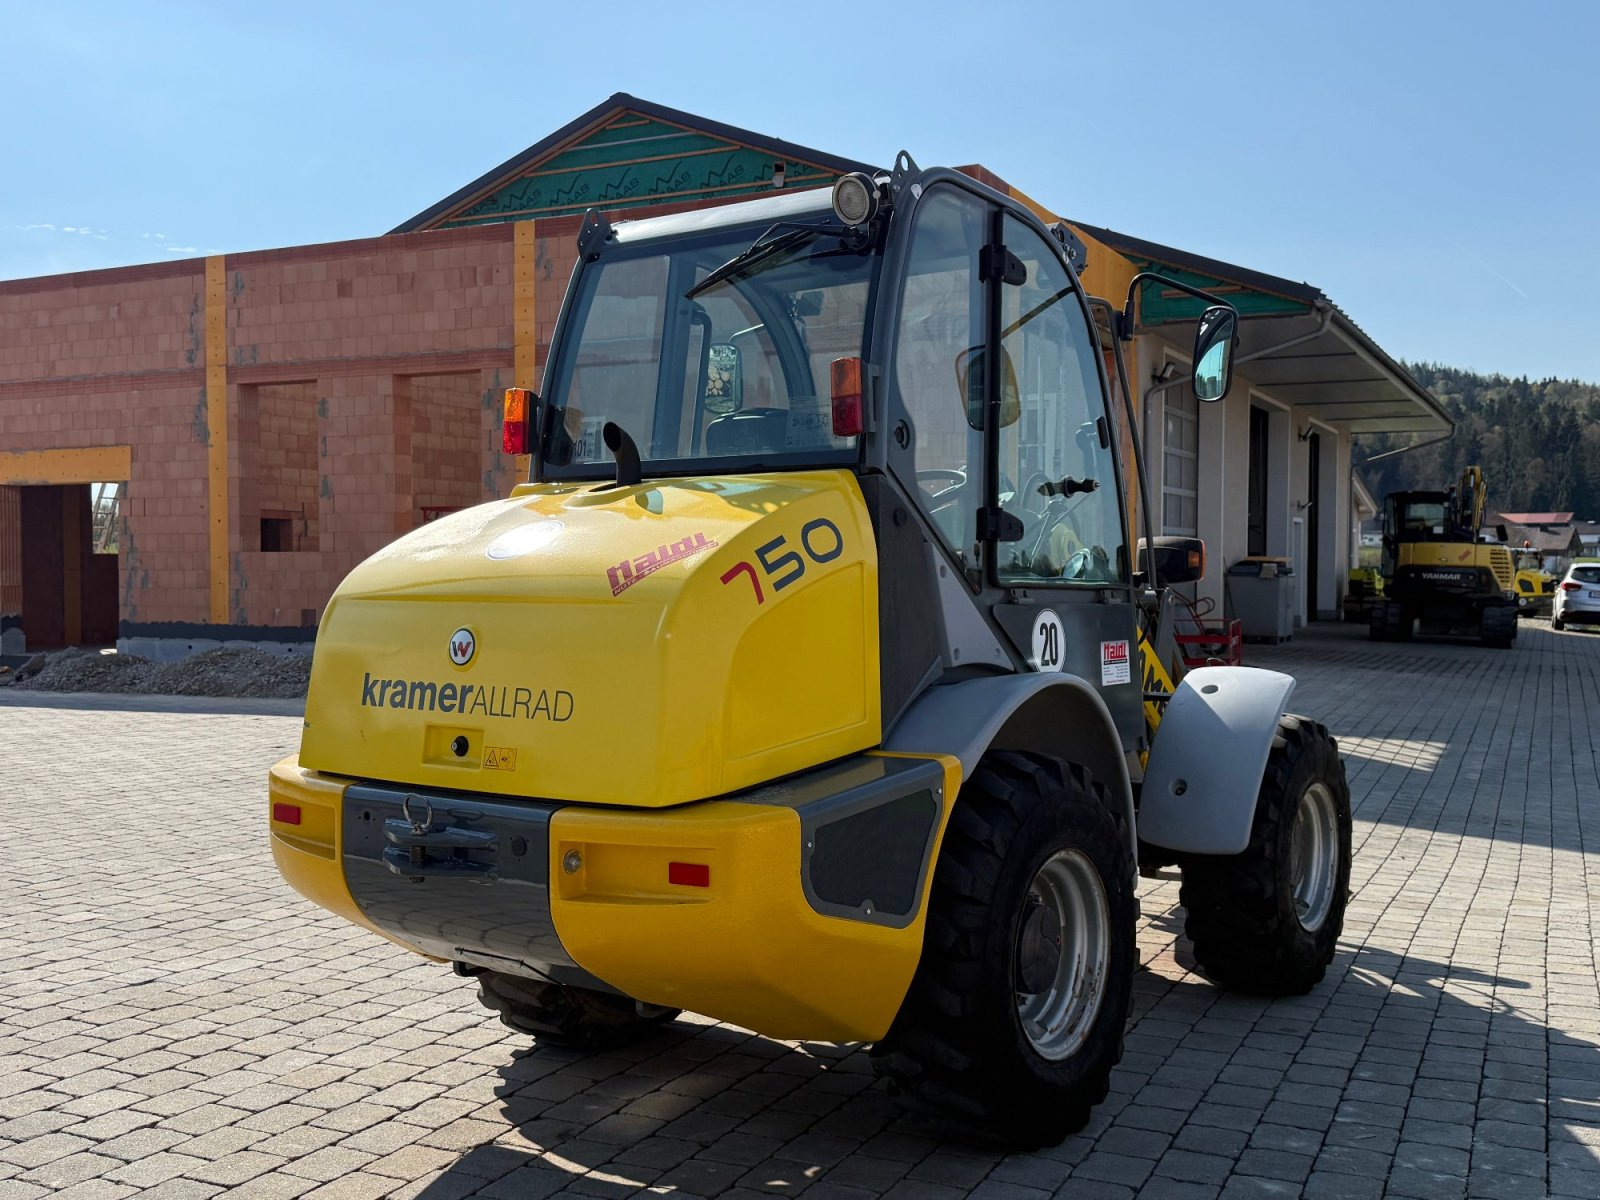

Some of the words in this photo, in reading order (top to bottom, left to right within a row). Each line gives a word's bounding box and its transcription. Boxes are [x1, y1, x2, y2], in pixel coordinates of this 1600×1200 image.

[720, 518, 843, 605] 750
[1422, 572, 1461, 581] YANMAR
[1039, 622, 1058, 667] 20
